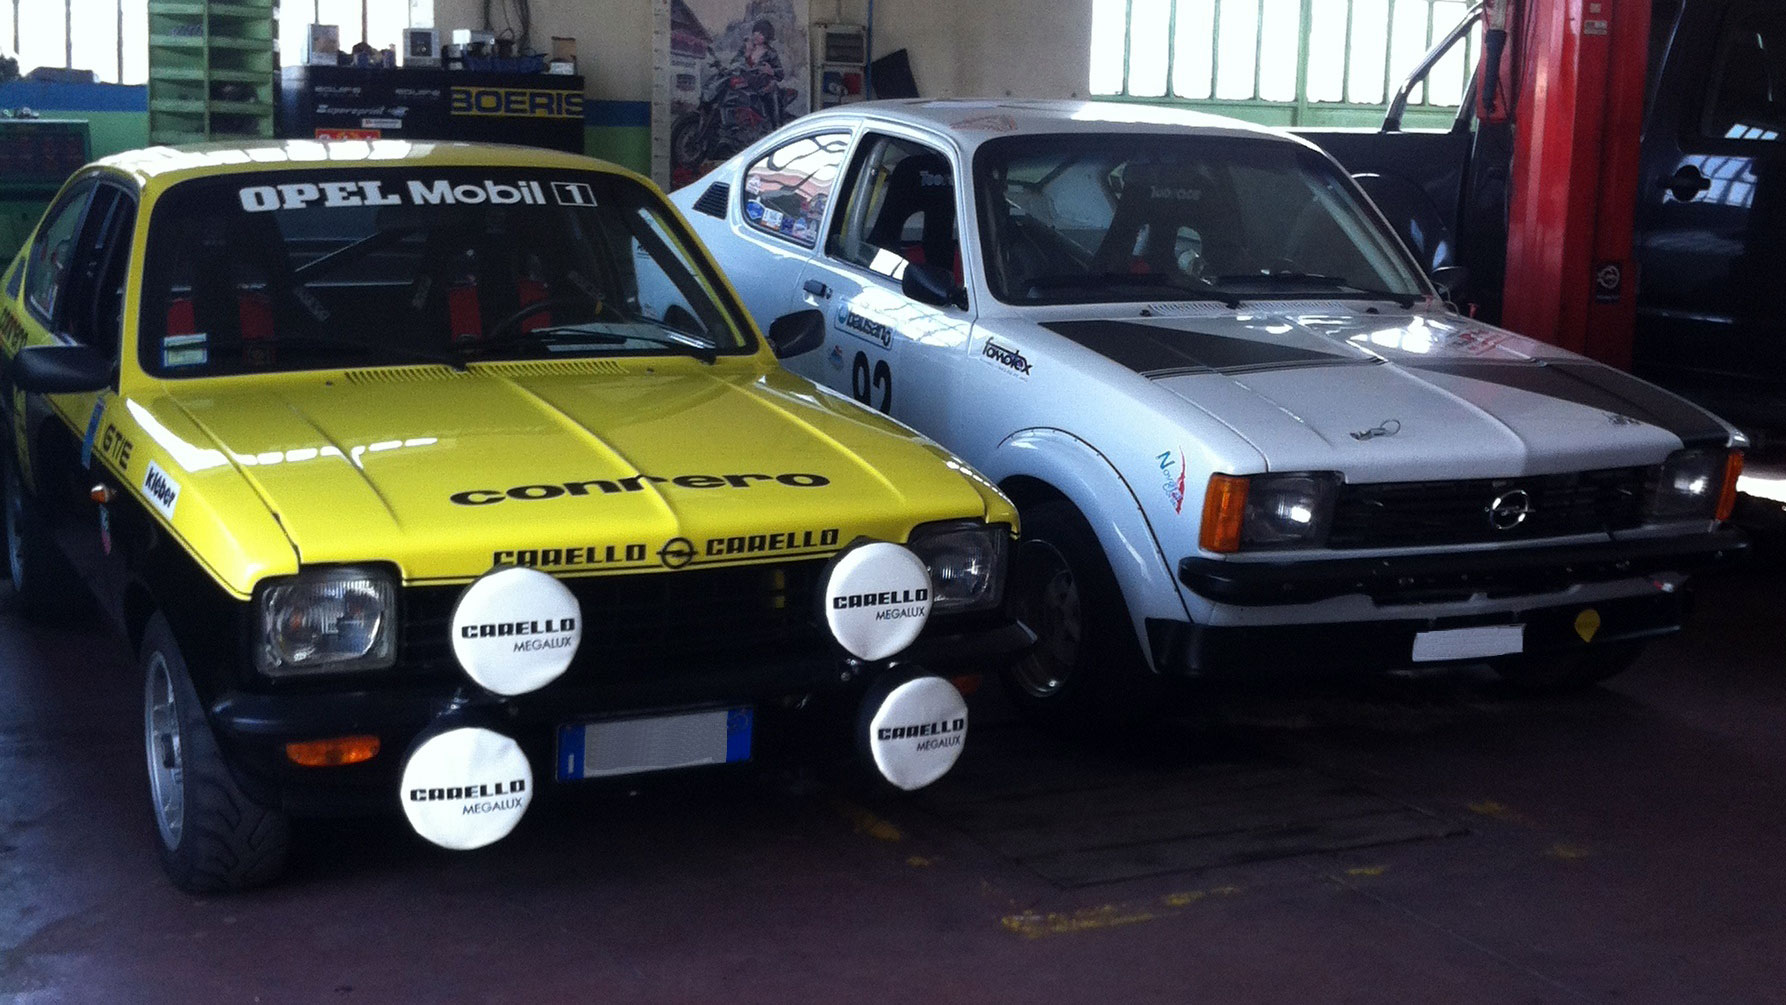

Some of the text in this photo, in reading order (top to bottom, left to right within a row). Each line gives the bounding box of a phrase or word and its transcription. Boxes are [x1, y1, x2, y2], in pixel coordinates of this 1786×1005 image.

[450, 89, 584, 118] BOERIS
[239, 181, 402, 212] OPEL
[406, 180, 547, 205] Mobil
[450, 472, 830, 506] conrero
[706, 528, 840, 557] CARELLO
[493, 544, 647, 568] CARELLO
[833, 588, 928, 610] CARELLO
[875, 606, 925, 621] MEGALUX
[461, 617, 576, 640] CARELLO
[513, 636, 572, 653] MEGALUX
[877, 718, 965, 742] CARELLO
[917, 735, 961, 752] MEGALUX
[410, 779, 526, 802] CARELLO
[462, 797, 523, 815] MEGALUX
